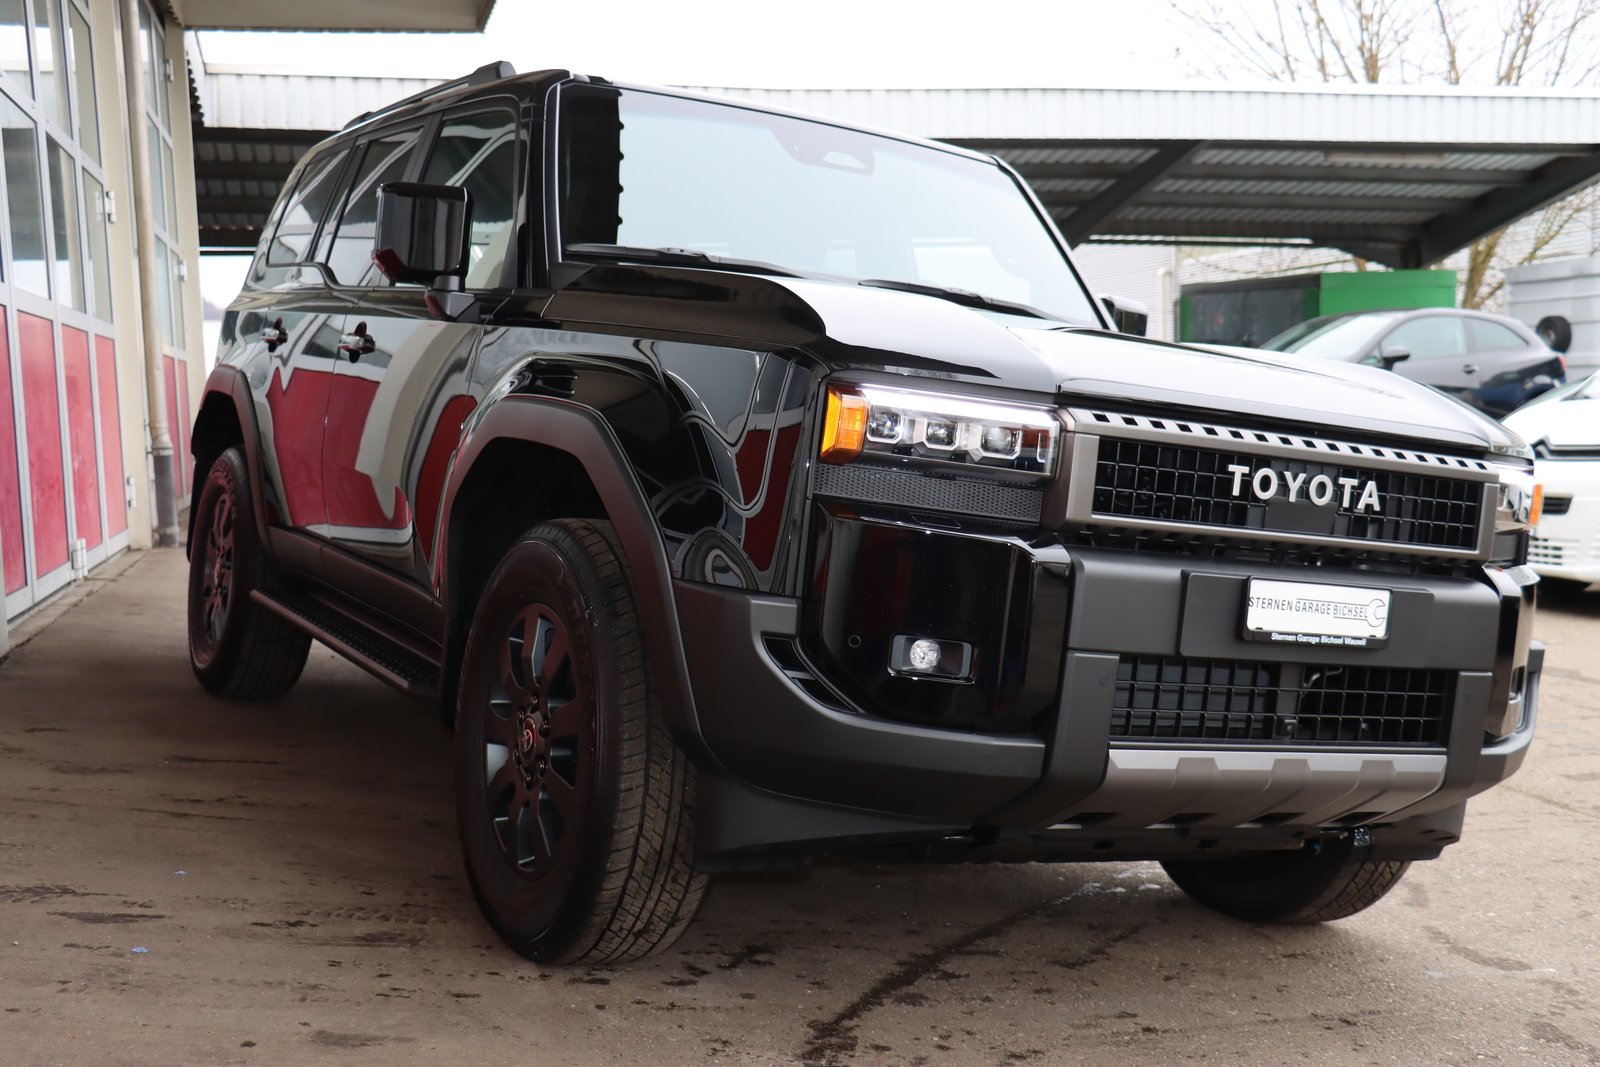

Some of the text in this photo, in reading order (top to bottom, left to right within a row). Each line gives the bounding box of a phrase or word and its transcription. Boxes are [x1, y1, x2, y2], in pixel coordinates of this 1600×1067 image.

[1228, 464, 1381, 511] TOYOTA
[1248, 597, 1368, 618] STERNEN GARAGE BICHSEL
[1271, 632, 1296, 642] Sternen
[1297, 634, 1320, 644] Garage
[1320, 635, 1343, 645] Bichsel
